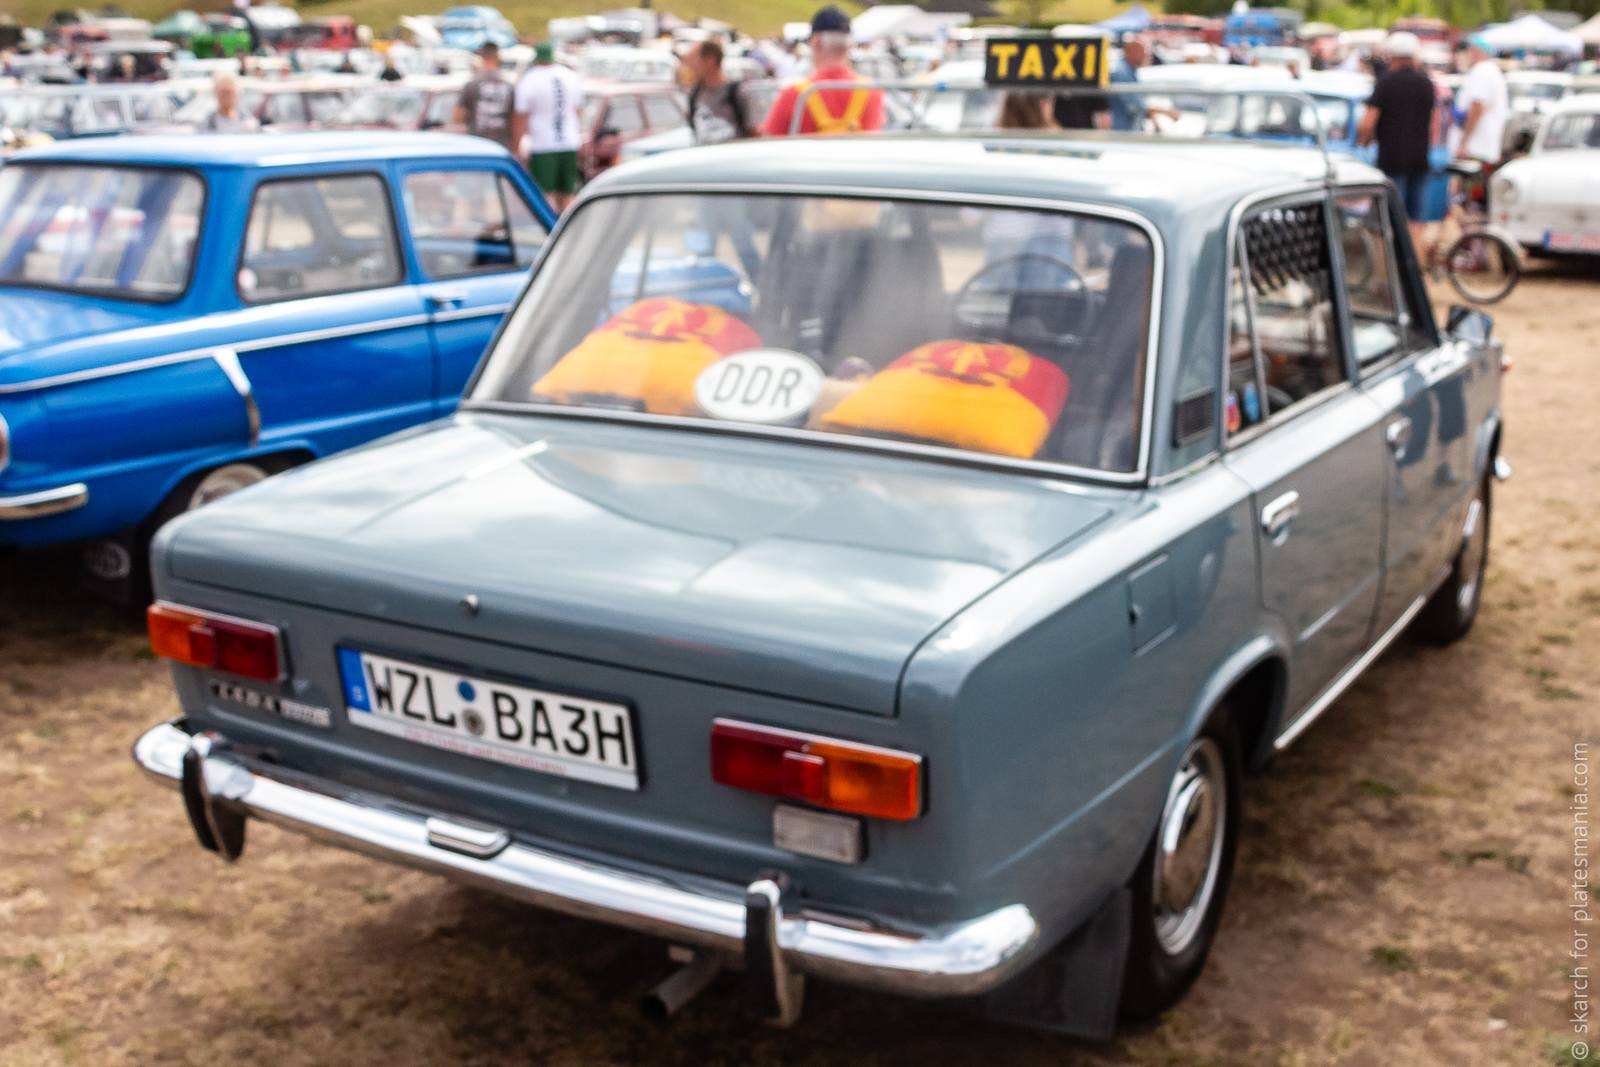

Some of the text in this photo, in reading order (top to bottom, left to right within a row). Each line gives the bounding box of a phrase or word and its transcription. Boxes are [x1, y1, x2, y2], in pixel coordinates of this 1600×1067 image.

[990, 43, 1097, 80] TAXI
[713, 363, 802, 408] DDR
[366, 662, 457, 728] WZL
[490, 691, 631, 767] BA3H
